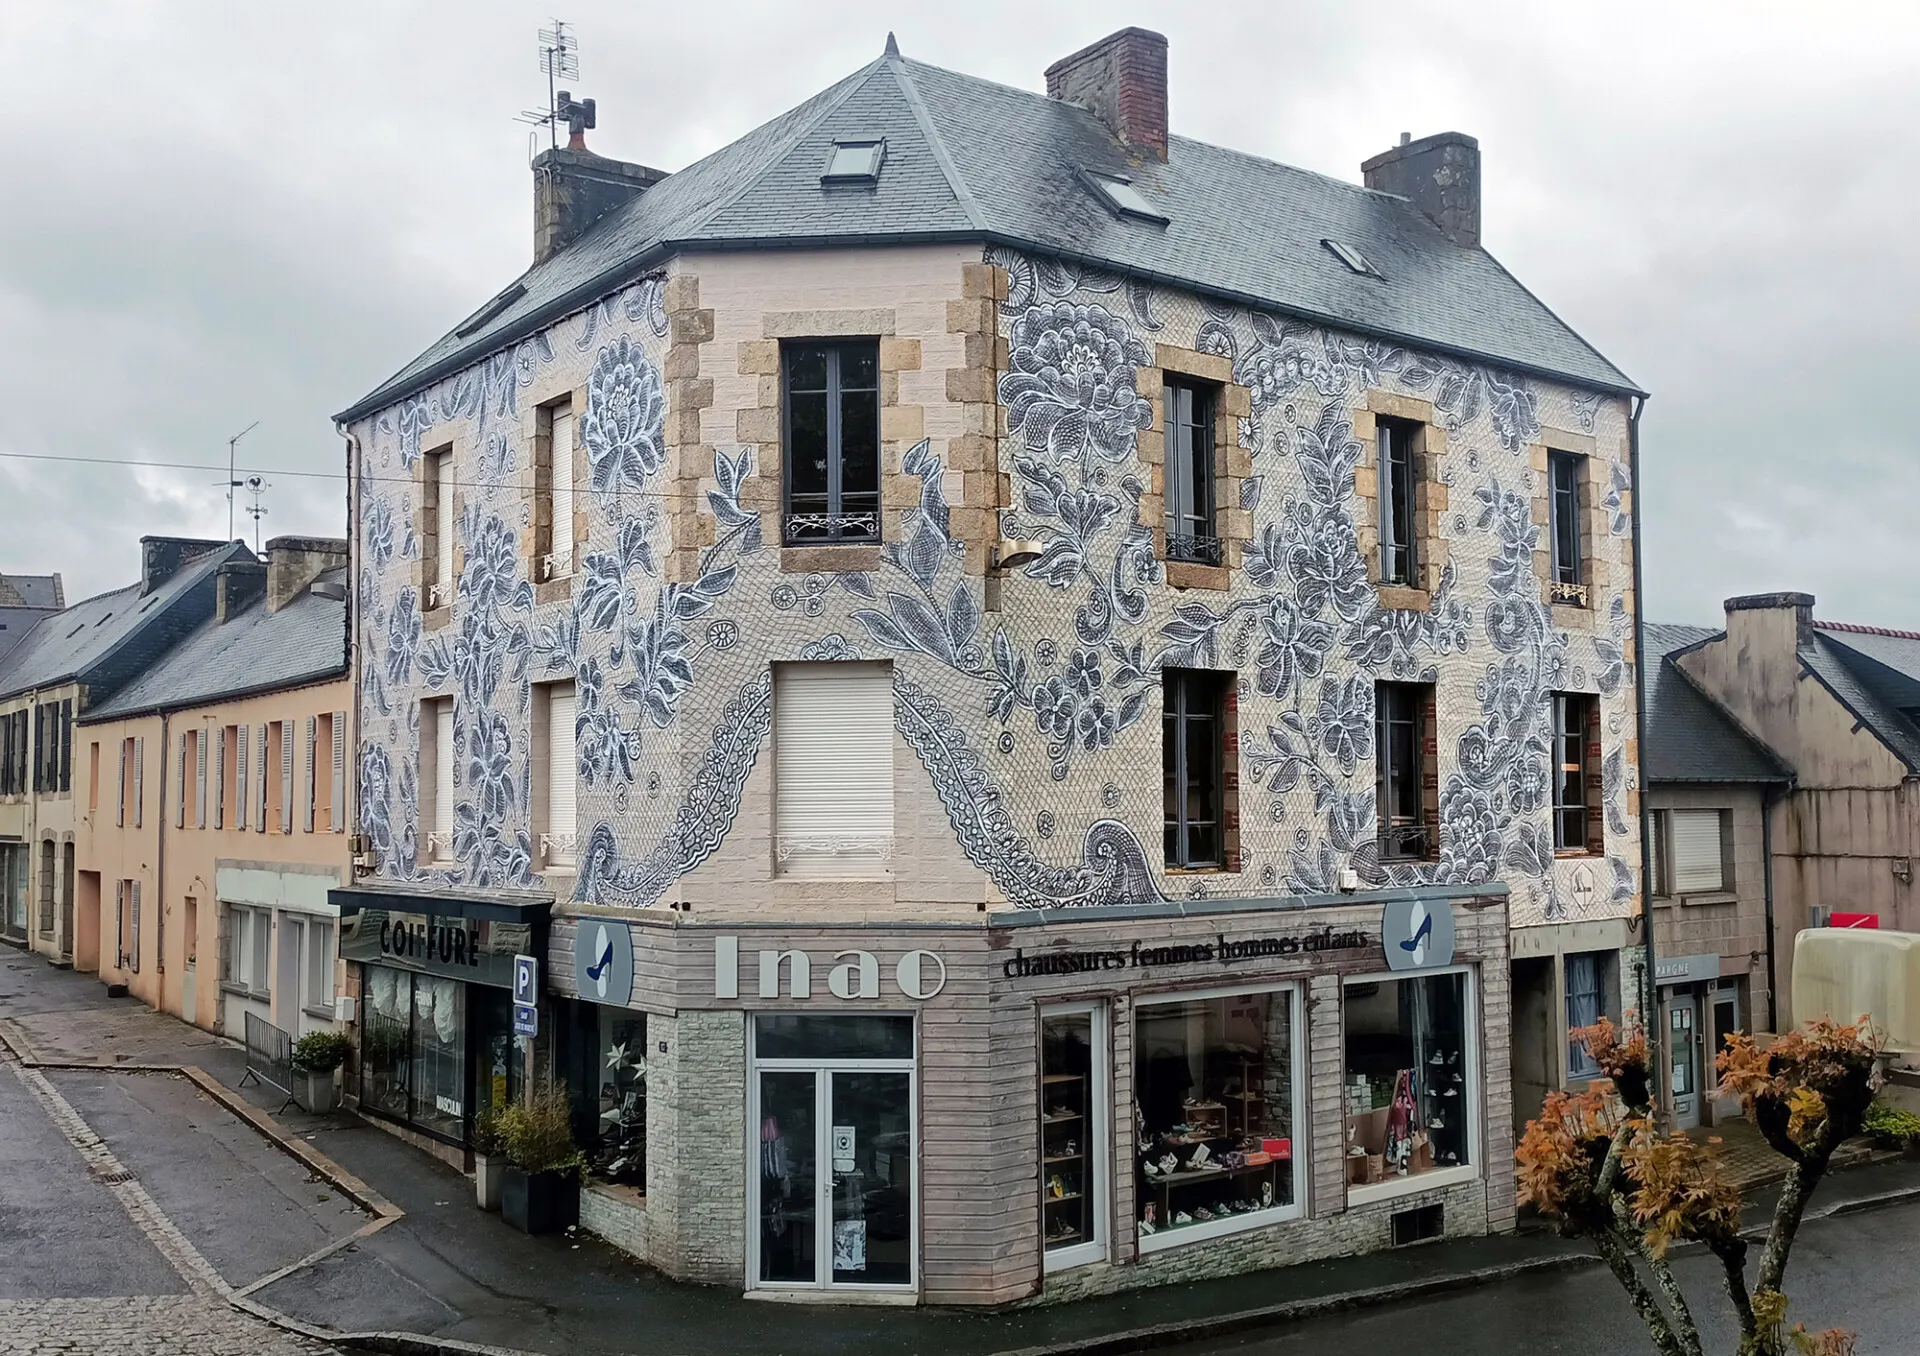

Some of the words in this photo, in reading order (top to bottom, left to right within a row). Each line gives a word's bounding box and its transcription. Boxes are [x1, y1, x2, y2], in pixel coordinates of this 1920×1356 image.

[380, 919, 480, 967] COIFFURE
[1003, 948, 1126, 977] chaussures
[1132, 940, 1213, 967] femmes
[1217, 934, 1299, 959] hommes
[1303, 926, 1368, 950] enfants
[519, 966, 529, 995] P
[715, 936, 946, 999] Inao
[1655, 963, 1689, 975] PARGNE
